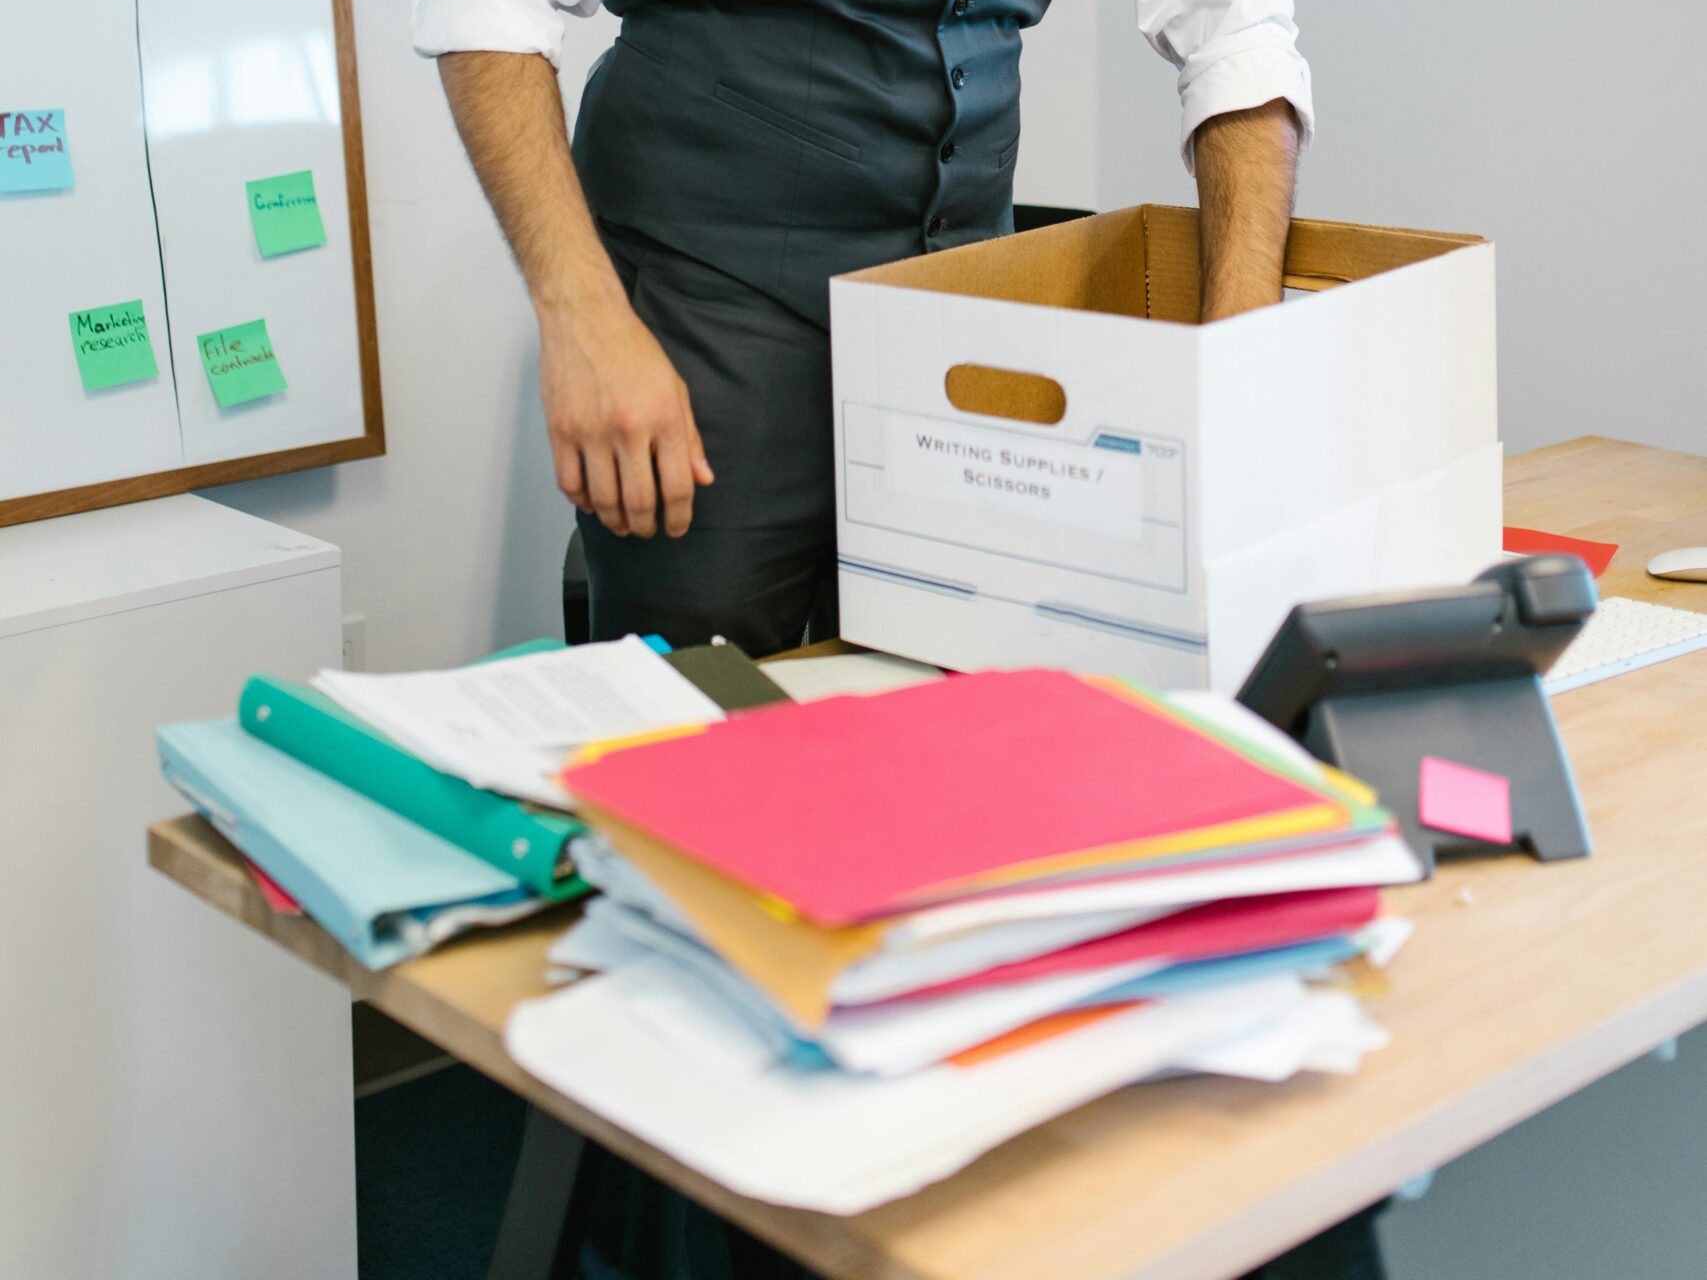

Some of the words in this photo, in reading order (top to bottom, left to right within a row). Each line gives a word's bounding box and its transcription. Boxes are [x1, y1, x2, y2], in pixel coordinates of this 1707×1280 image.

[0, 112, 58, 139] TAX
[80, 327, 147, 355] research
[203, 333, 247, 360] File
